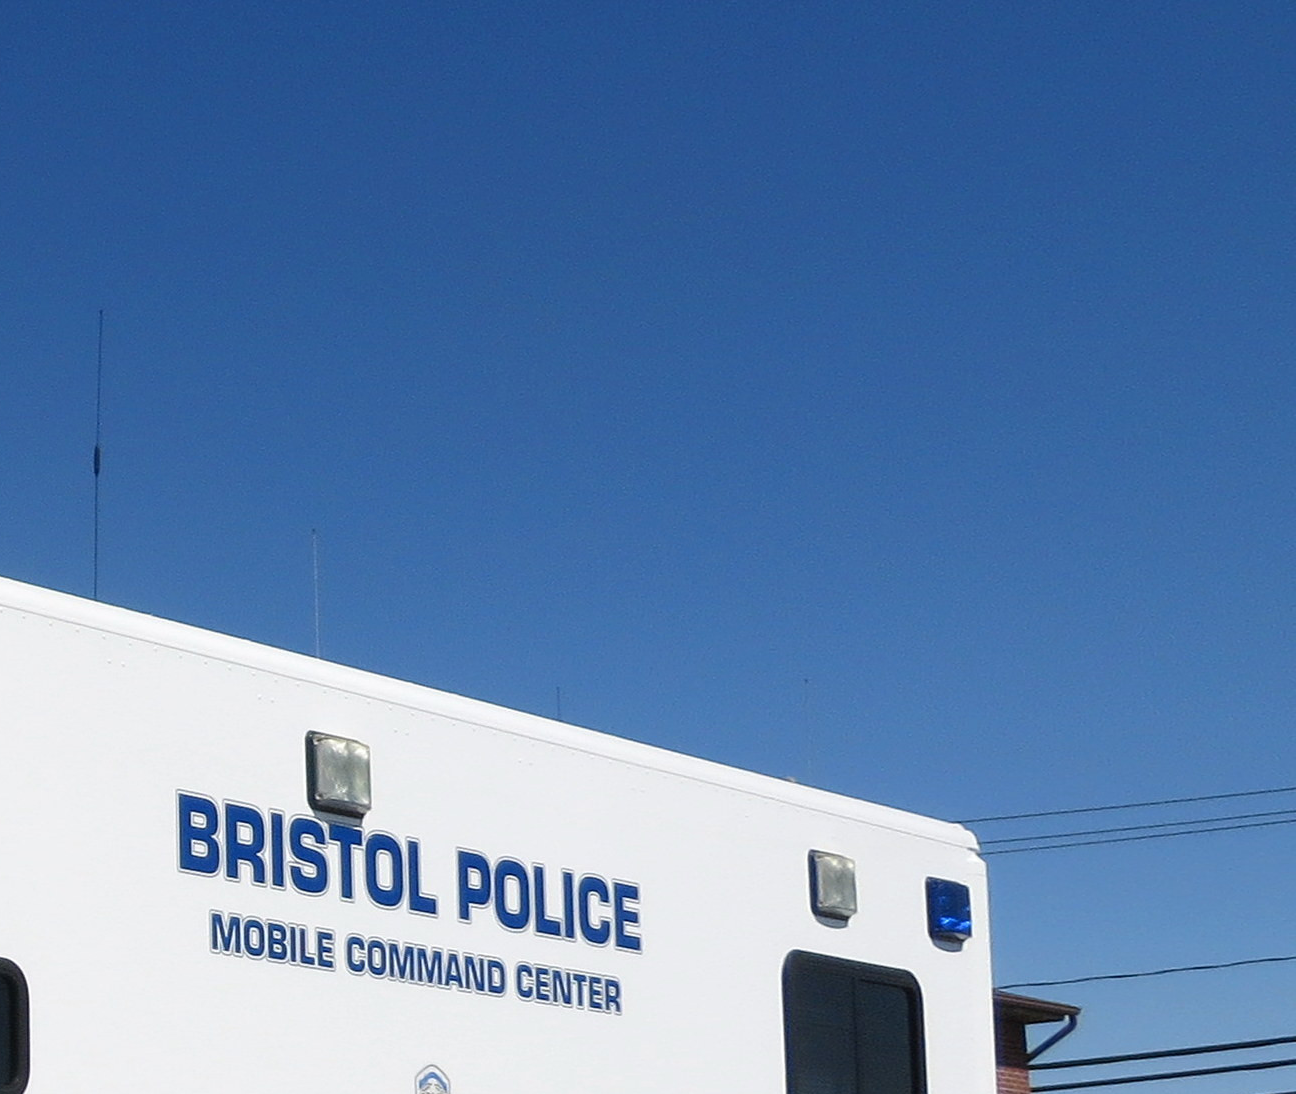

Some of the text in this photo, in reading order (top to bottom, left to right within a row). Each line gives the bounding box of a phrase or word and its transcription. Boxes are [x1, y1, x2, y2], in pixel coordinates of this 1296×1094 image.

[177, 790, 643, 953] BRISTOL POLICE
[209, 910, 622, 1015] MOBILE COMMAND CENTER
